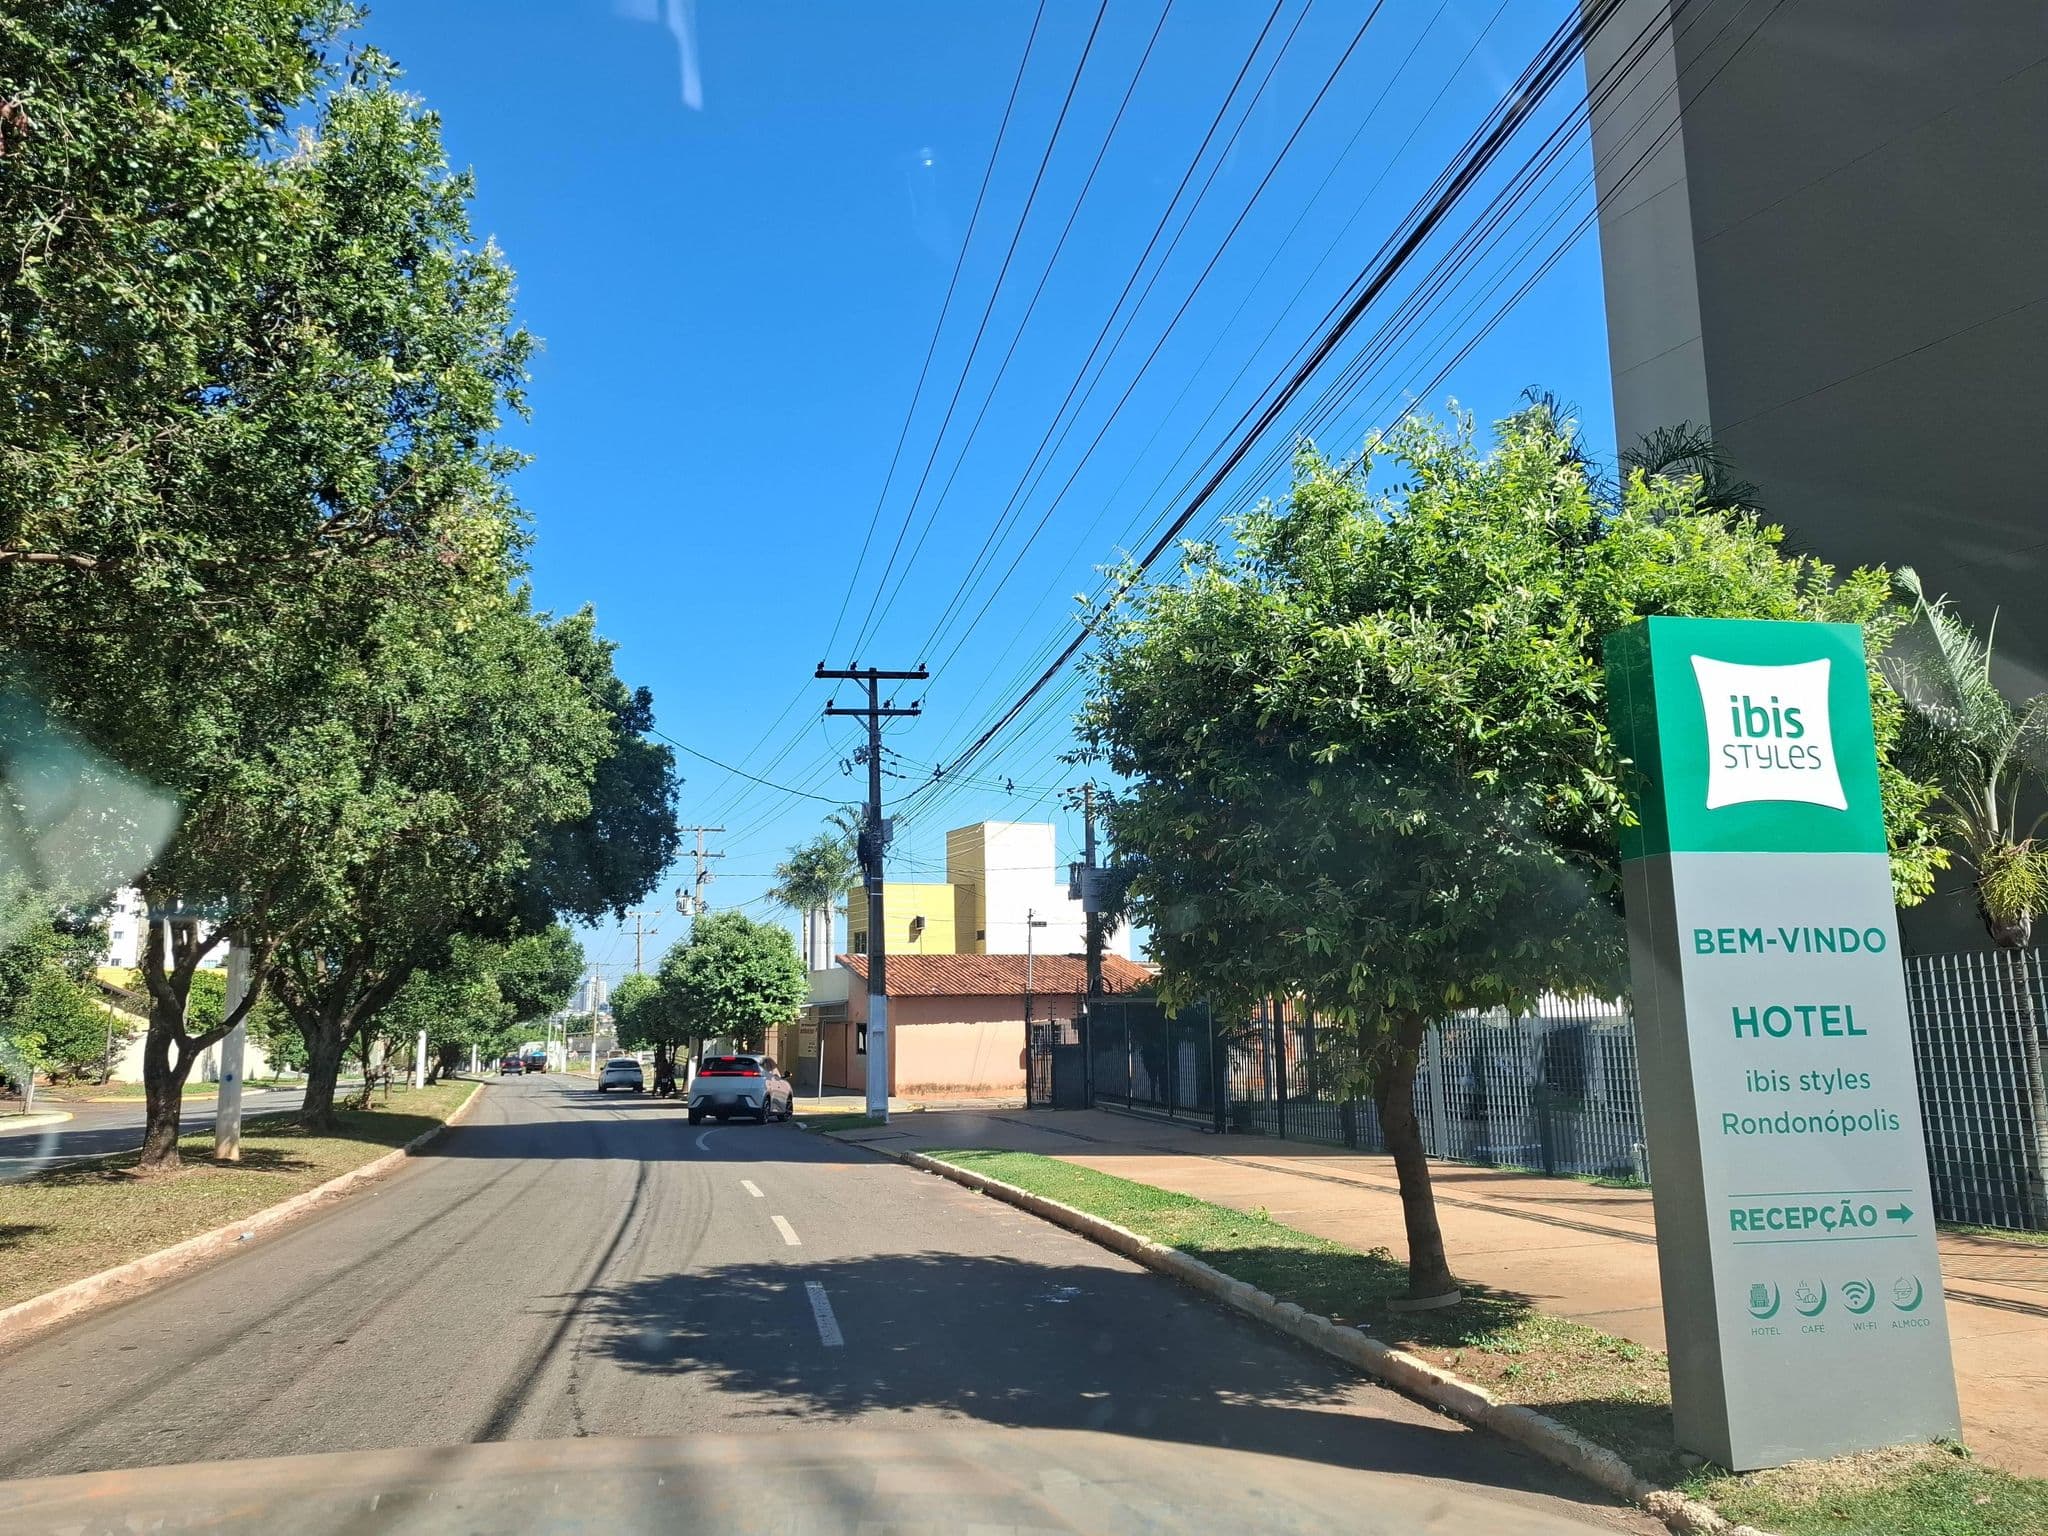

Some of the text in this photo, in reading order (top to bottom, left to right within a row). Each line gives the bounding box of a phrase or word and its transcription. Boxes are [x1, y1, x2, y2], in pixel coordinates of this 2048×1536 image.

[1730, 695, 1804, 738] ibis
[1694, 928, 1886, 954] BEM-VINDO
[1733, 1005, 1867, 1038] HOTEL
[1746, 1067, 1871, 1095] ibis styles
[1722, 1109, 1900, 1137] Rondonópolis
[1729, 1199, 1878, 1232] RECEPÇÃO
[1751, 1327, 1781, 1336] HOTEL
[1852, 1321, 1877, 1331] WI-FI
